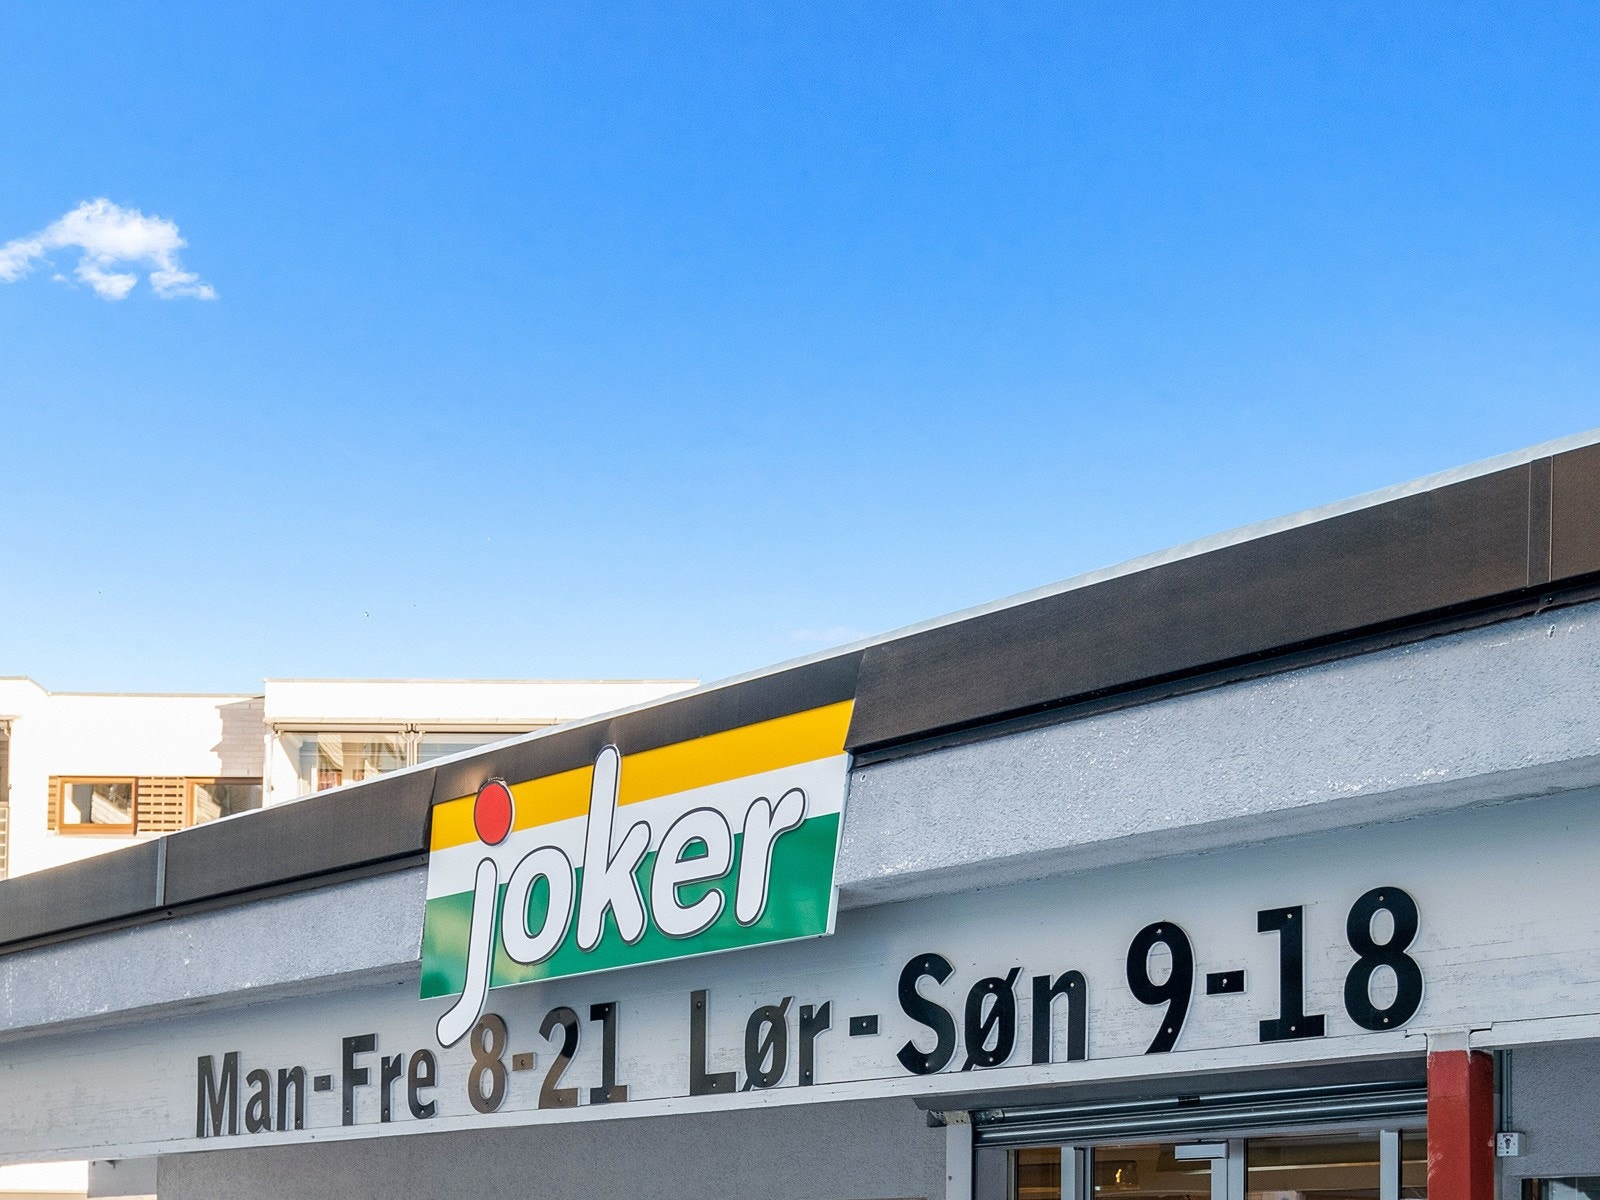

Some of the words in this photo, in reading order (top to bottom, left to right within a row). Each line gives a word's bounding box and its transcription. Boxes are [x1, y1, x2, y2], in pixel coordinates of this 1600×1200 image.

[195, 1032, 439, 1138] Man-Fre
[467, 1001, 630, 1113] 8-21
[1125, 885, 1425, 1056] 9-18
[436, 744, 808, 1049] joker
